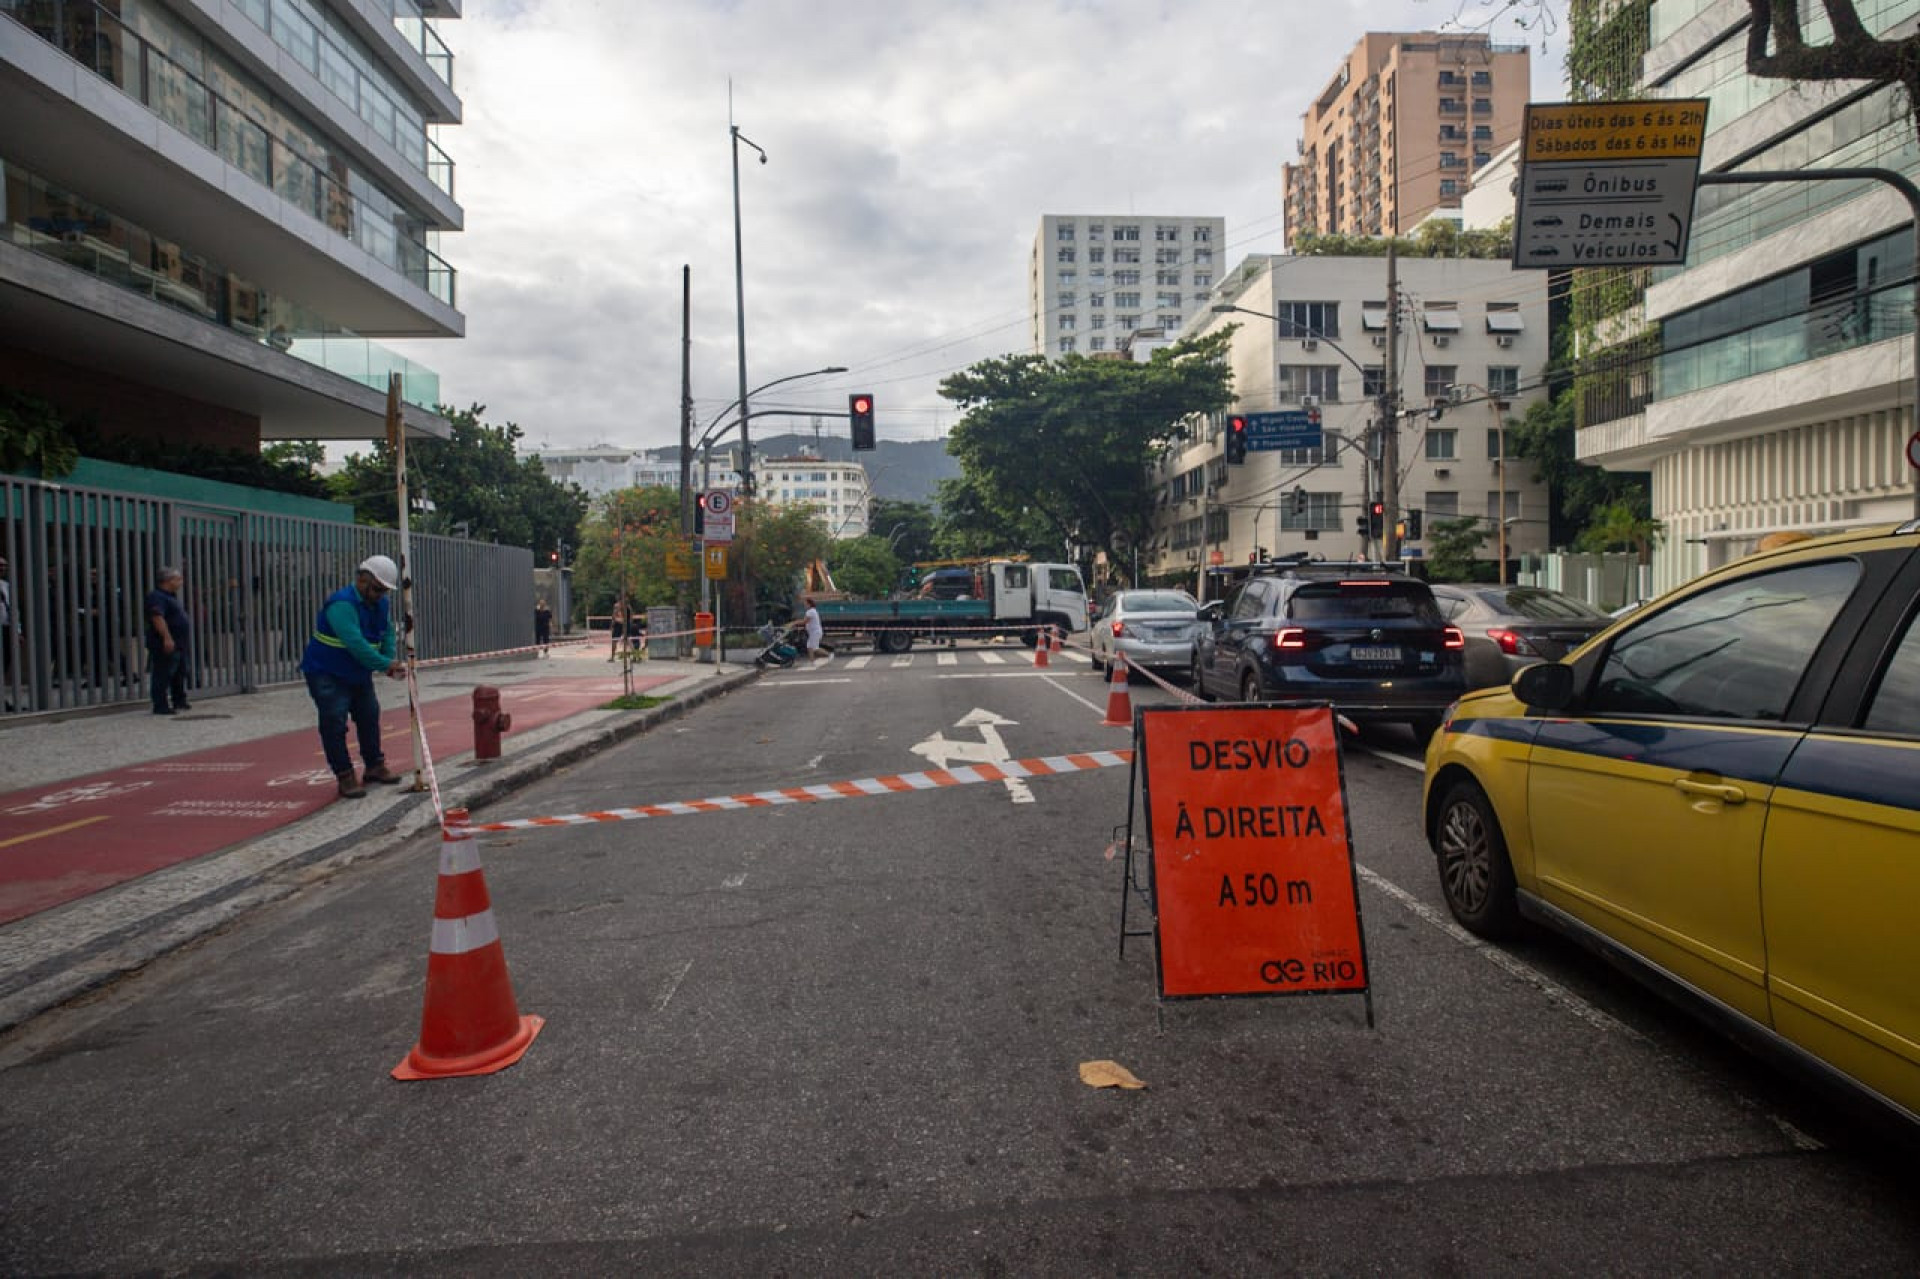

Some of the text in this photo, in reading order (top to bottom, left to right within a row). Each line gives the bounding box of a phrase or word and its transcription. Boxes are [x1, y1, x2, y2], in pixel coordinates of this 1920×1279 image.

[1531, 116, 1562, 130] Dias
[1609, 114, 1635, 127] das
[1643, 112, 1652, 126] 6
[1679, 110, 1701, 126] 21h
[1535, 137, 1597, 153] Sábados
[1606, 136, 1632, 150] das
[1636, 134, 1645, 149] 6
[1673, 133, 1696, 147] 14h
[1583, 172, 1657, 193] Ônibus
[1580, 212, 1656, 230] Demais
[1572, 241, 1658, 260] Veículos
[713, 495, 722, 509] E
[1189, 739, 1311, 770] DESVIO
[1175, 801, 1326, 840] À DIREITA
[1218, 873, 1312, 907] A 50 m
[1313, 960, 1357, 982] RIO
